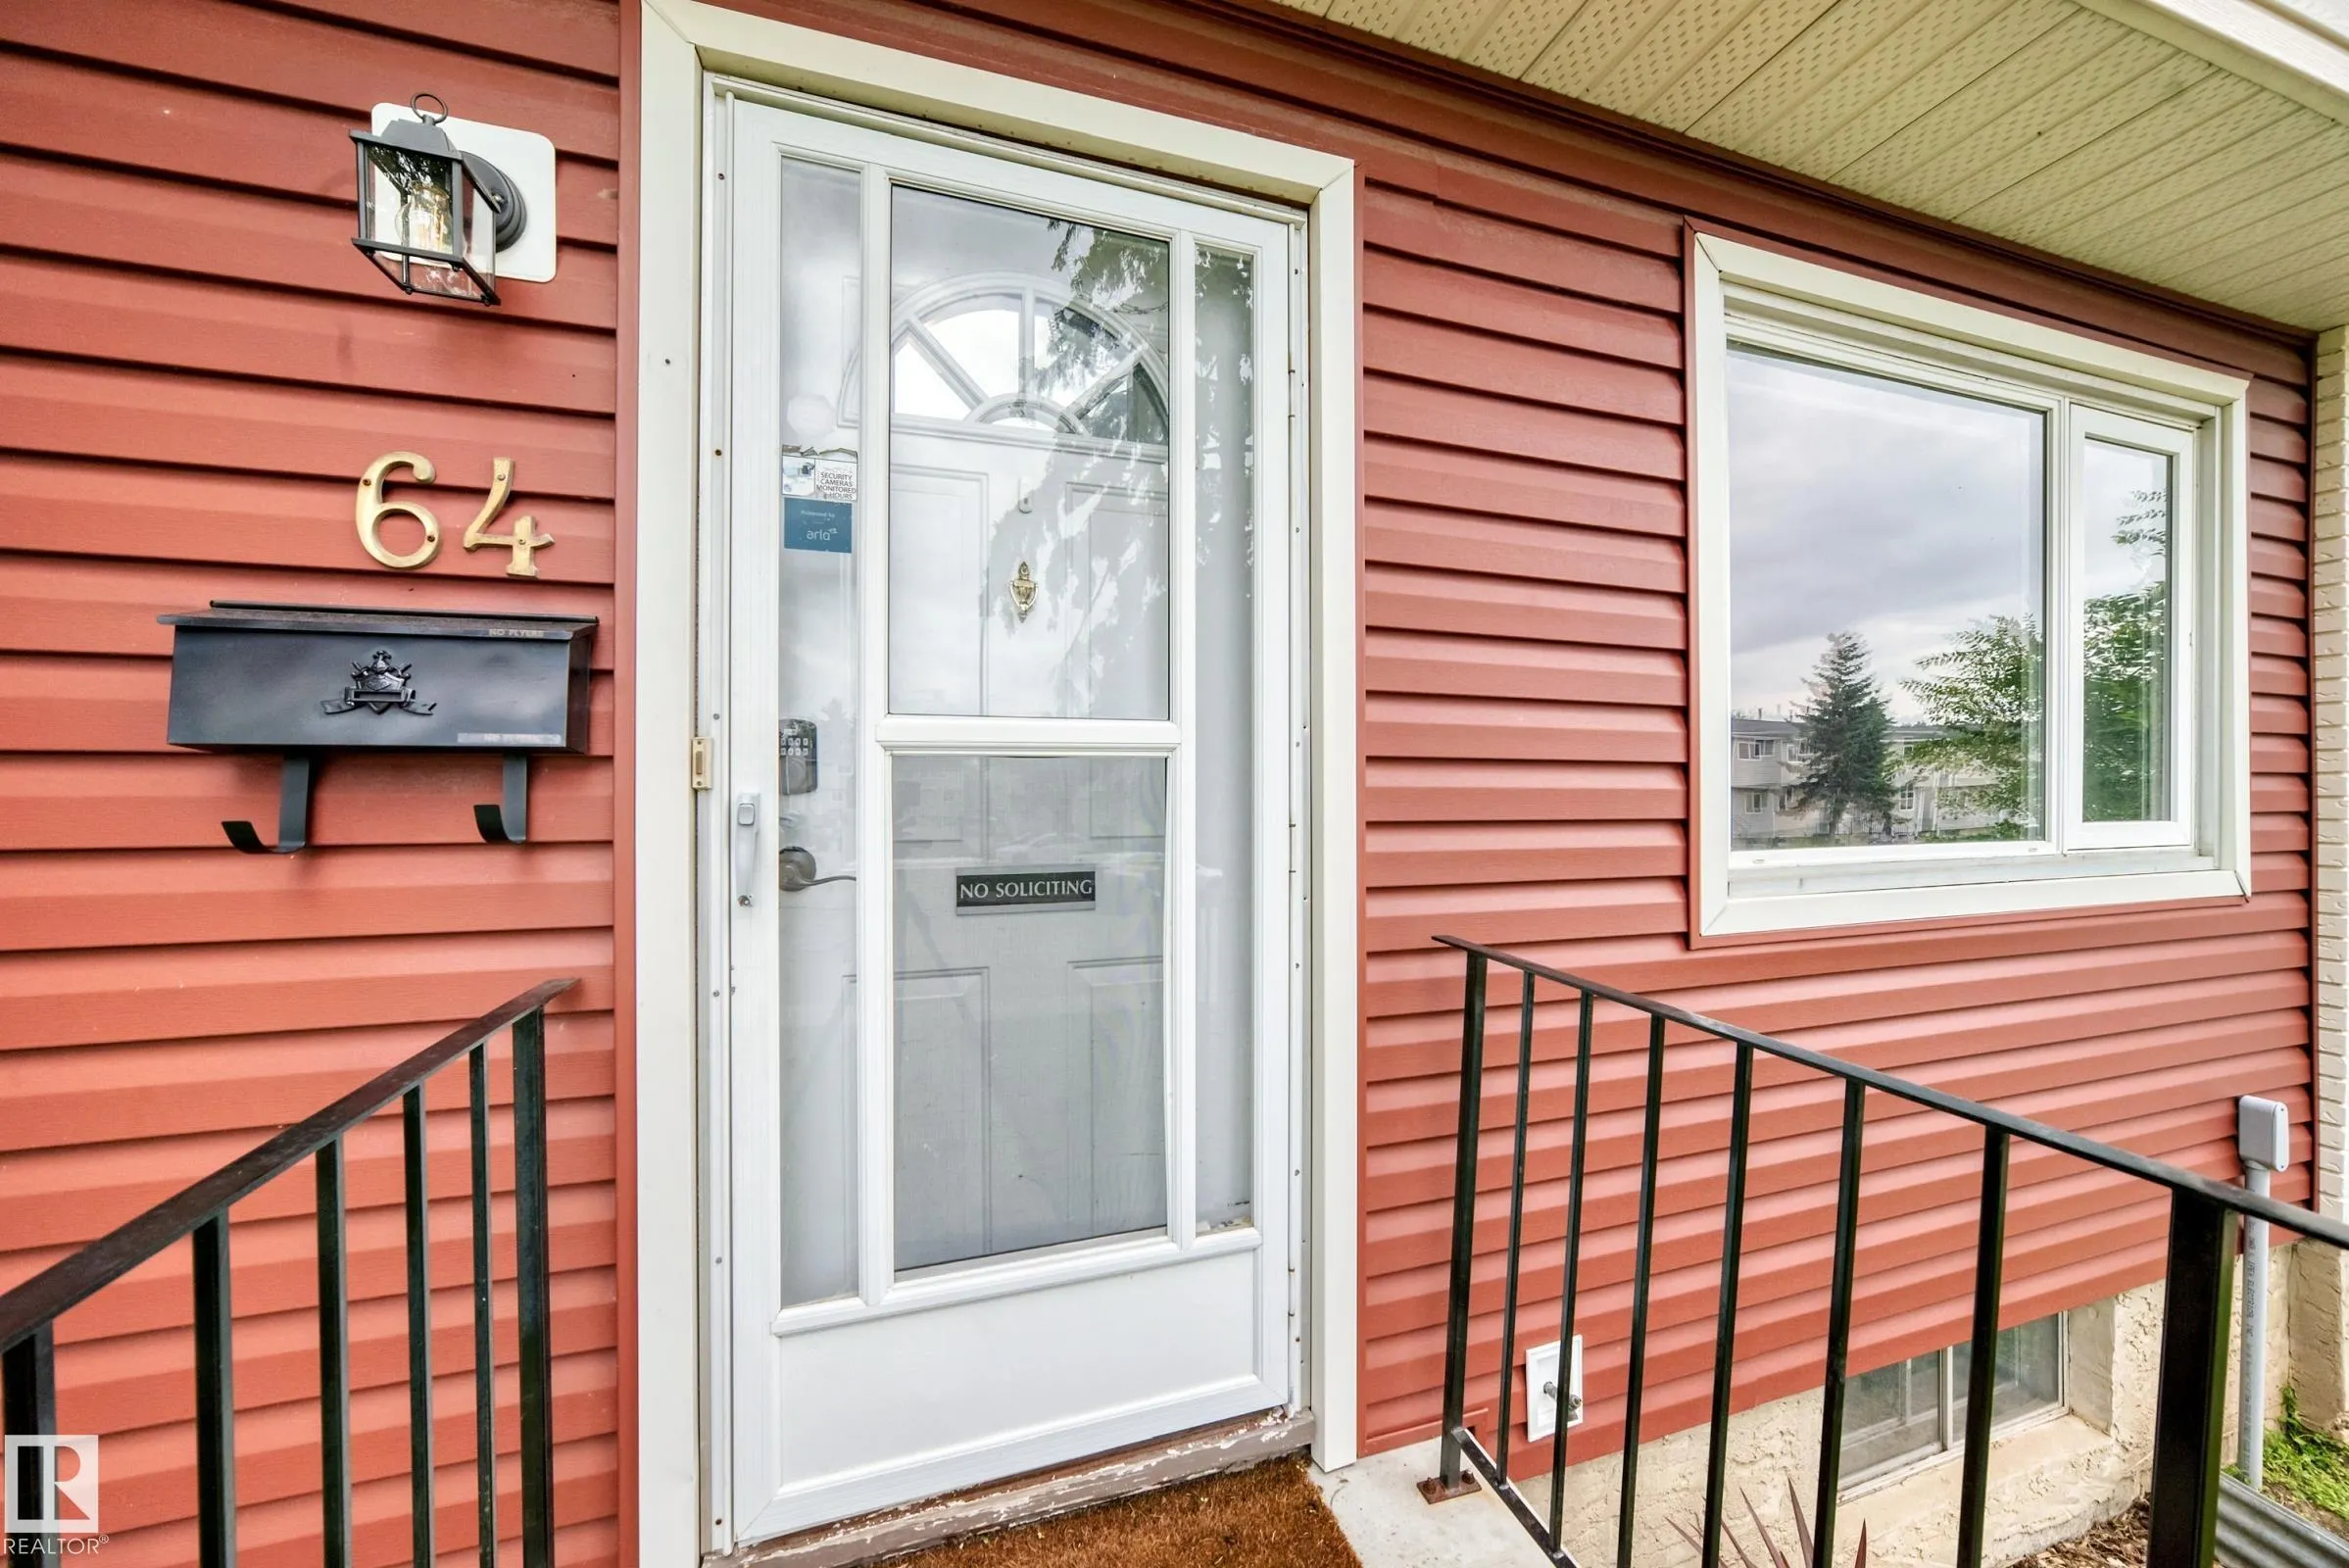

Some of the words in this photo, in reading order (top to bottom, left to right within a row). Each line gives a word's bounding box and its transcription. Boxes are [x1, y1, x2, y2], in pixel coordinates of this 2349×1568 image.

[816, 484, 856, 493] MONITORED
[355, 451, 556, 577] 64
[807, 529, 830, 540] arlo
[960, 883, 989, 899] NO
[996, 879, 1093, 898] SOLICITING
